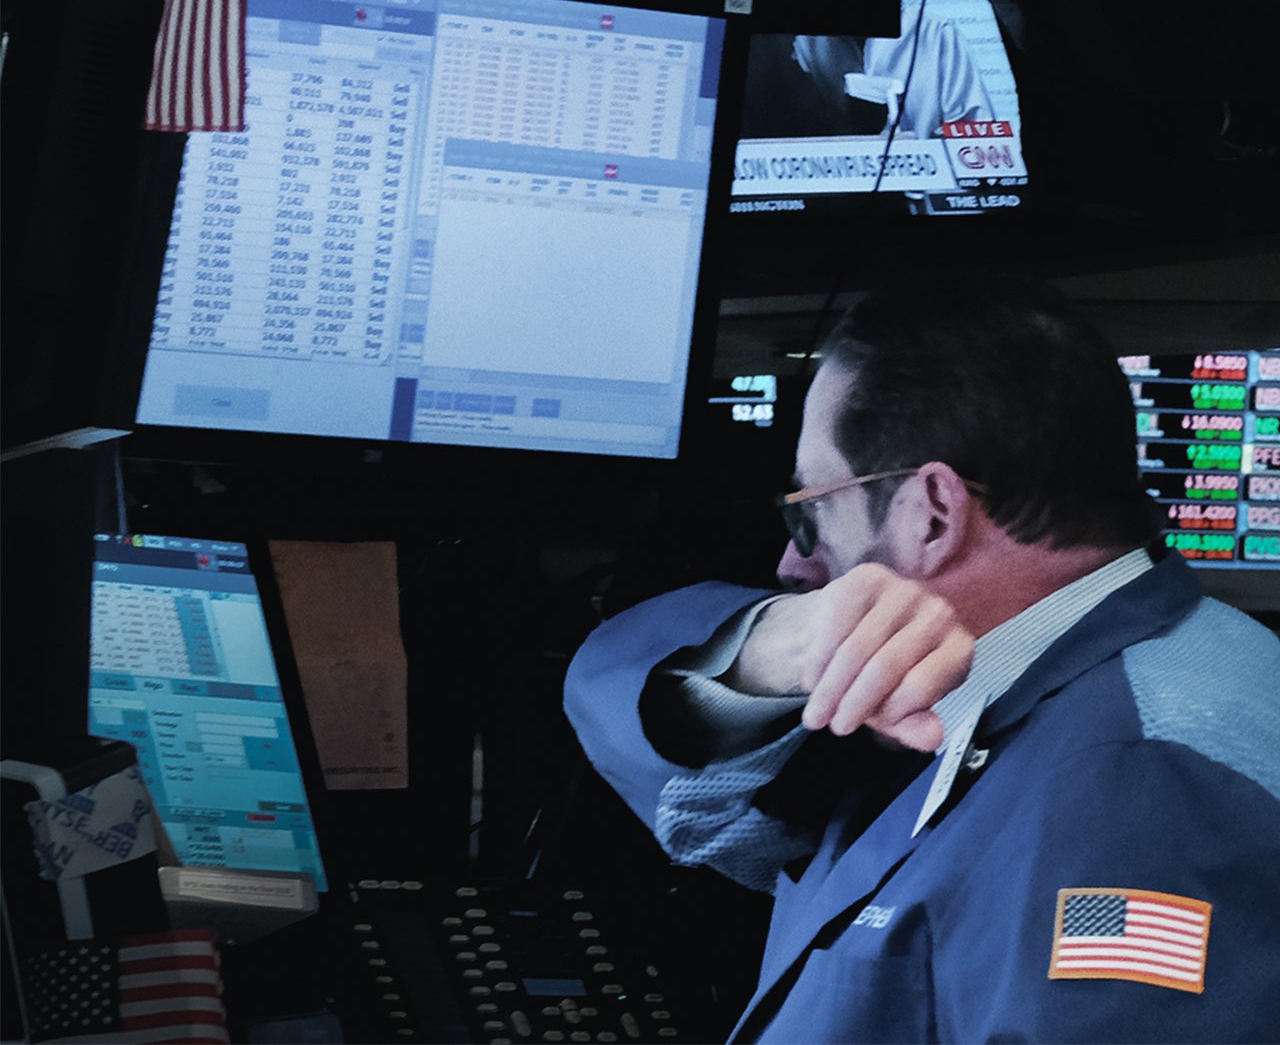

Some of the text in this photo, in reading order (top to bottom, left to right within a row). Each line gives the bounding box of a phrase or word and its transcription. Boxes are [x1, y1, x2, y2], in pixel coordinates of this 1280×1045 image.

[950, 122, 1007, 137] LIVE
[957, 144, 1015, 170] CNN
[945, 195, 1021, 208] THE LEAD
